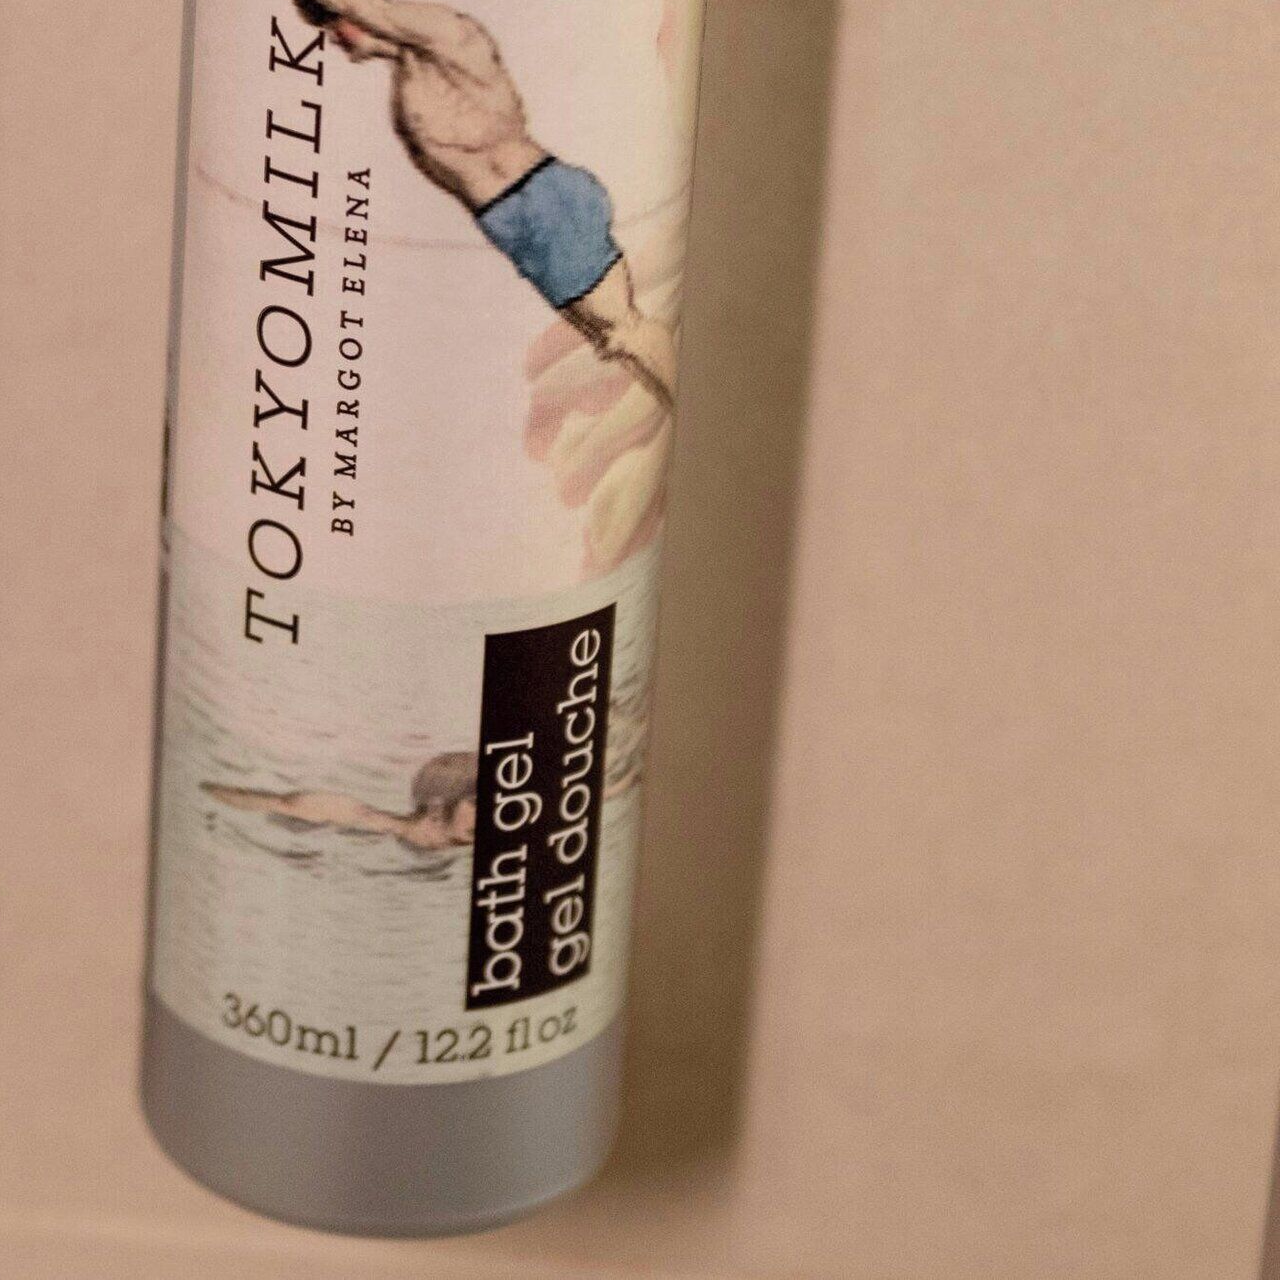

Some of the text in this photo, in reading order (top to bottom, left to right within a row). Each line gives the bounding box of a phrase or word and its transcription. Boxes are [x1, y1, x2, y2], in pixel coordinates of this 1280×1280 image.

[244, 16, 325, 645] TOKYOMILK
[332, 168, 371, 537] BY MARGOT ELENA
[471, 731, 543, 997] bath gel
[545, 627, 601, 977] gel douche
[222, 992, 359, 1061] 360ml
[373, 1030, 400, 1071] /
[505, 1016, 532, 1054] fl
[539, 1005, 578, 1044] oz
